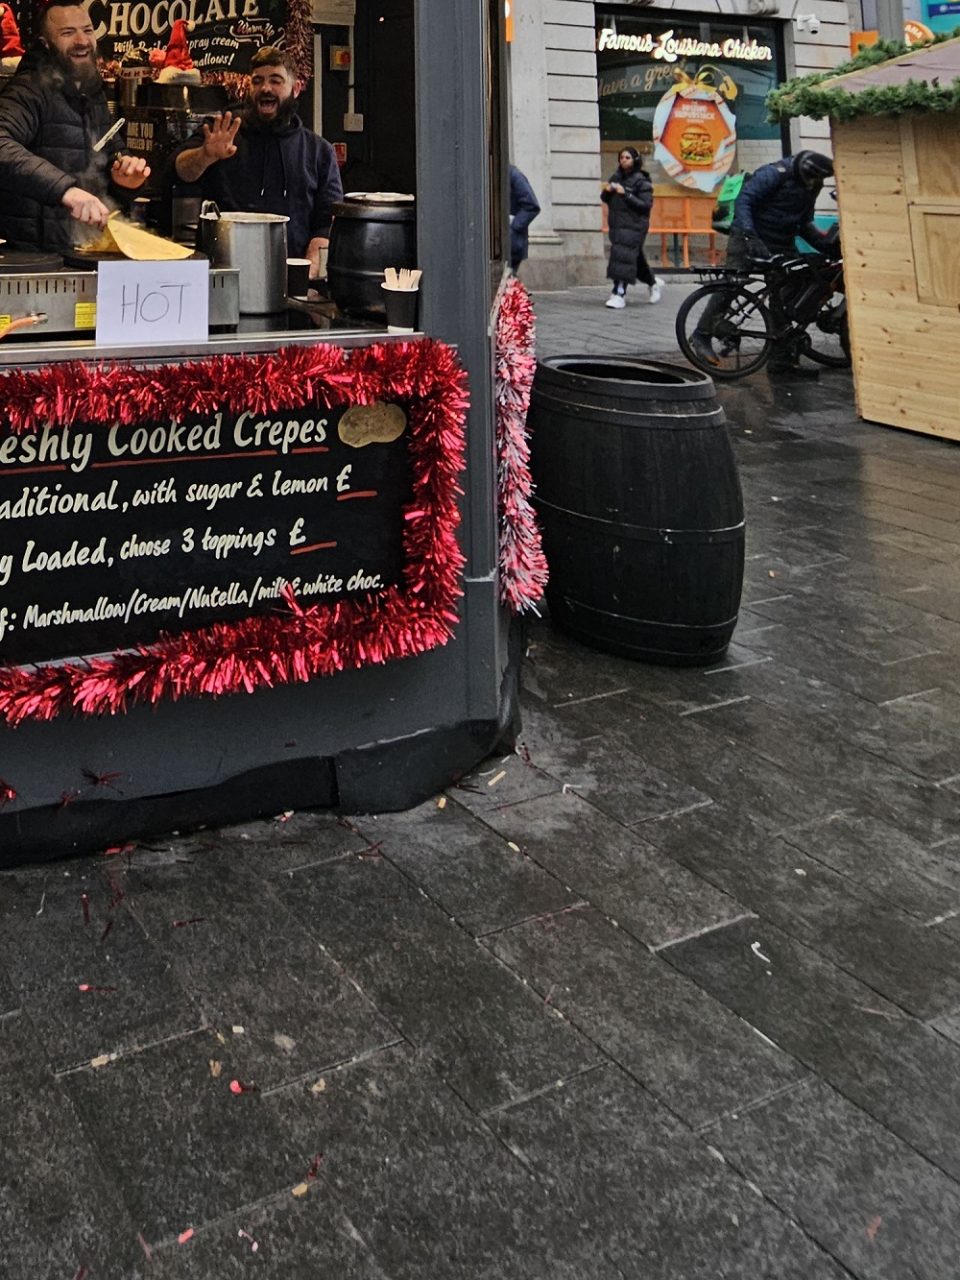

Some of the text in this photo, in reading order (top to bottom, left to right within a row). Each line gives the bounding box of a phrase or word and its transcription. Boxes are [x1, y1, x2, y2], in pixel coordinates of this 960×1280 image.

[188, 38, 210, 51] pray
[211, 36, 240, 50] cream
[598, 28, 773, 63] Famous Louisiana Chicken
[630, 74, 642, 89] a
[121, 283, 192, 324] HOT
[107, 413, 223, 456] Cooked
[233, 410, 328, 454] Crepes
[132, 477, 177, 507] with
[186, 481, 242, 510] sugar
[272, 470, 328, 496] lemon
[22, 537, 114, 573] Loaded,
[181, 527, 195, 553] 3
[201, 526, 277, 559] toppings
[302, 573, 343, 596] white
[346, 568, 385, 591] choc.
